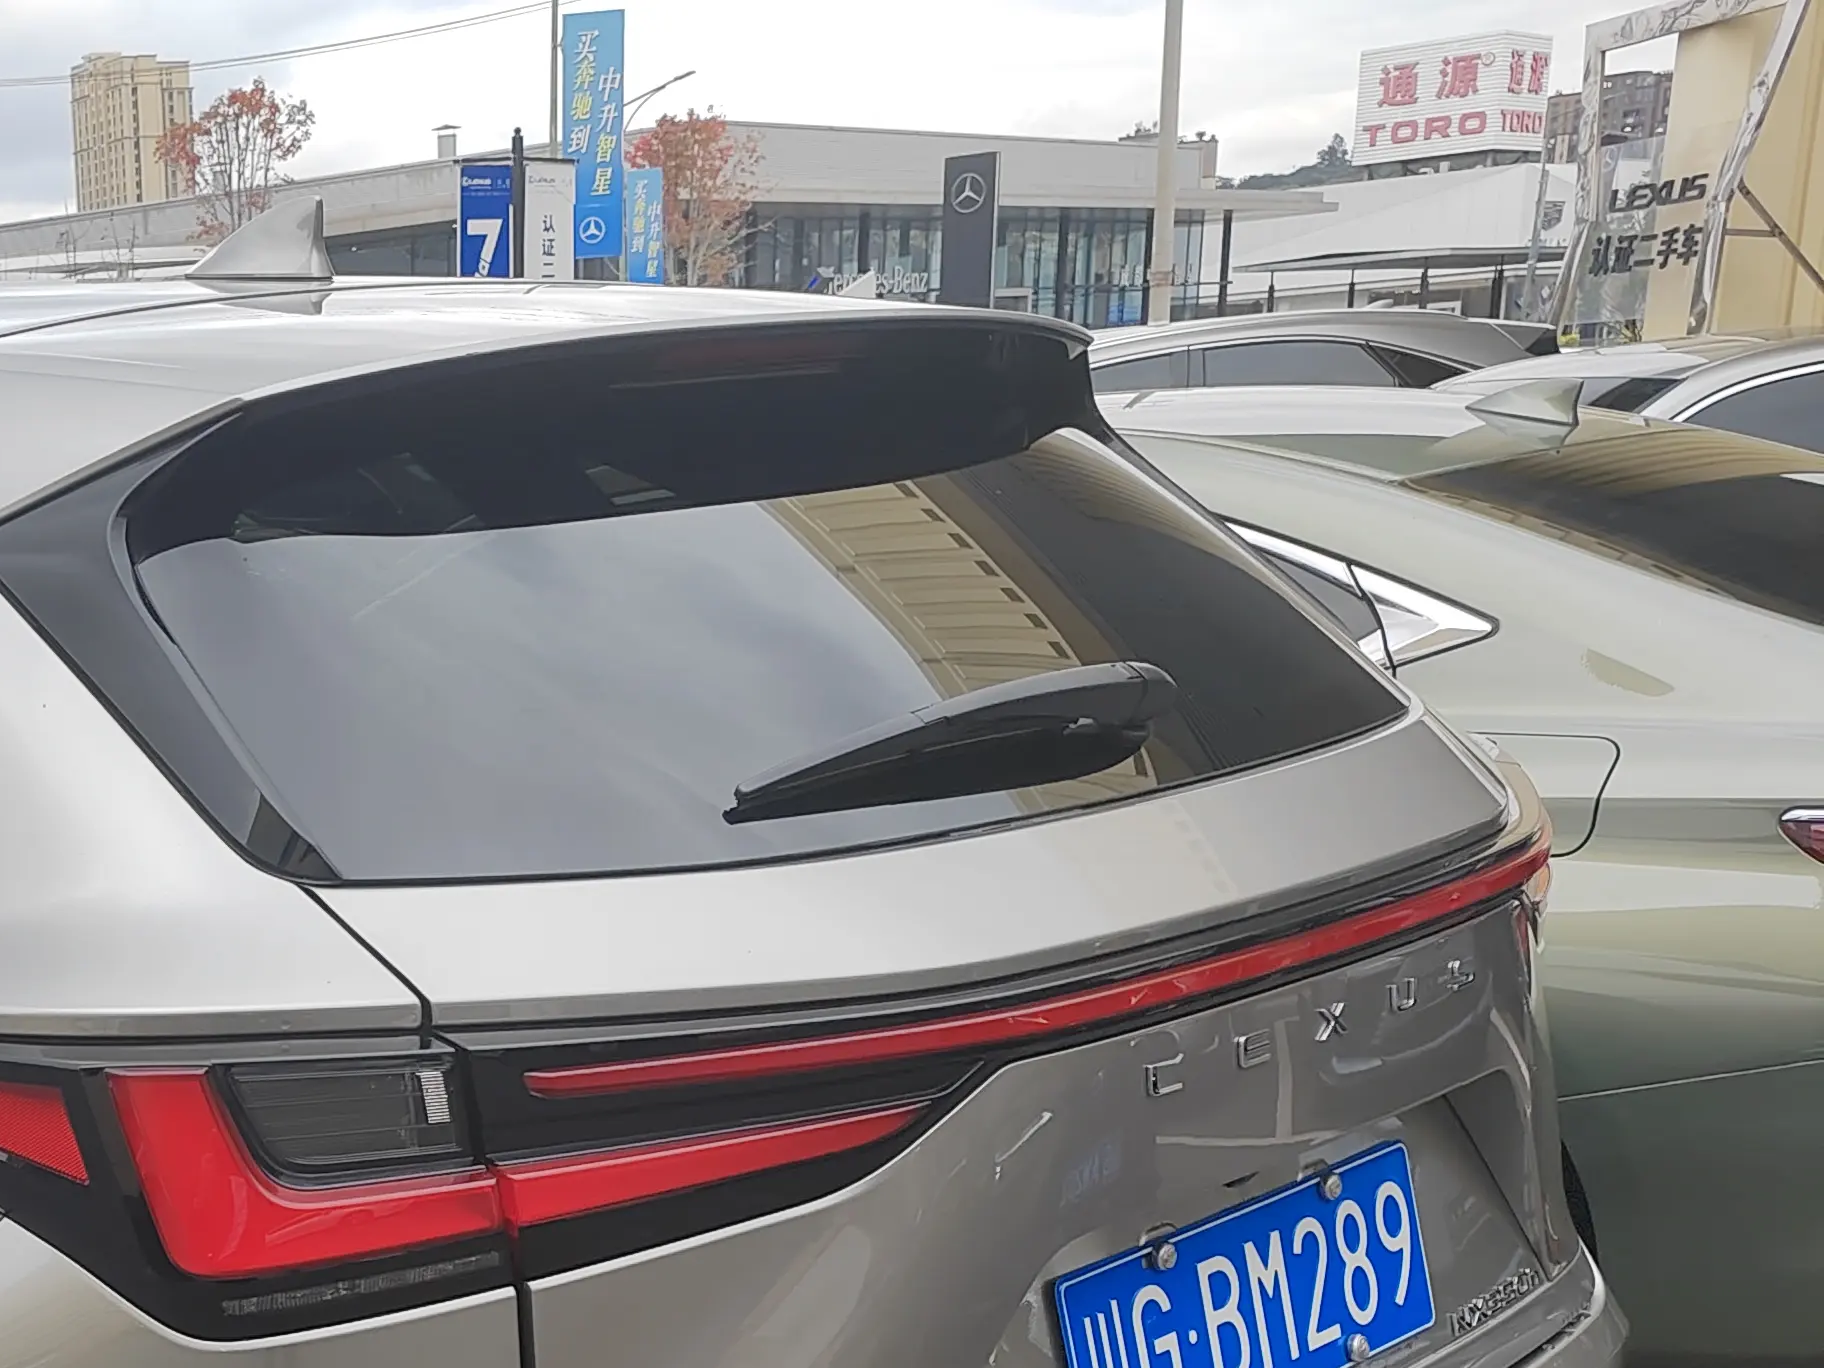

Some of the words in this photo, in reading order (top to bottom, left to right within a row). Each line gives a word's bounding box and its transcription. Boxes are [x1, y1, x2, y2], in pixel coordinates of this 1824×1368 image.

[568, 29, 599, 154] 买奔驰到
[1376, 53, 1482, 108] 通源
[589, 66, 621, 196] 中升智星
[1362, 110, 1487, 148] TORO
[1500, 109, 1543, 134] TORO
[1608, 173, 1709, 214] LEXUS
[466, 218, 504, 277] 7
[1587, 223, 1705, 278] 认证二手车
[1143, 959, 1475, 1097] LEXUS
